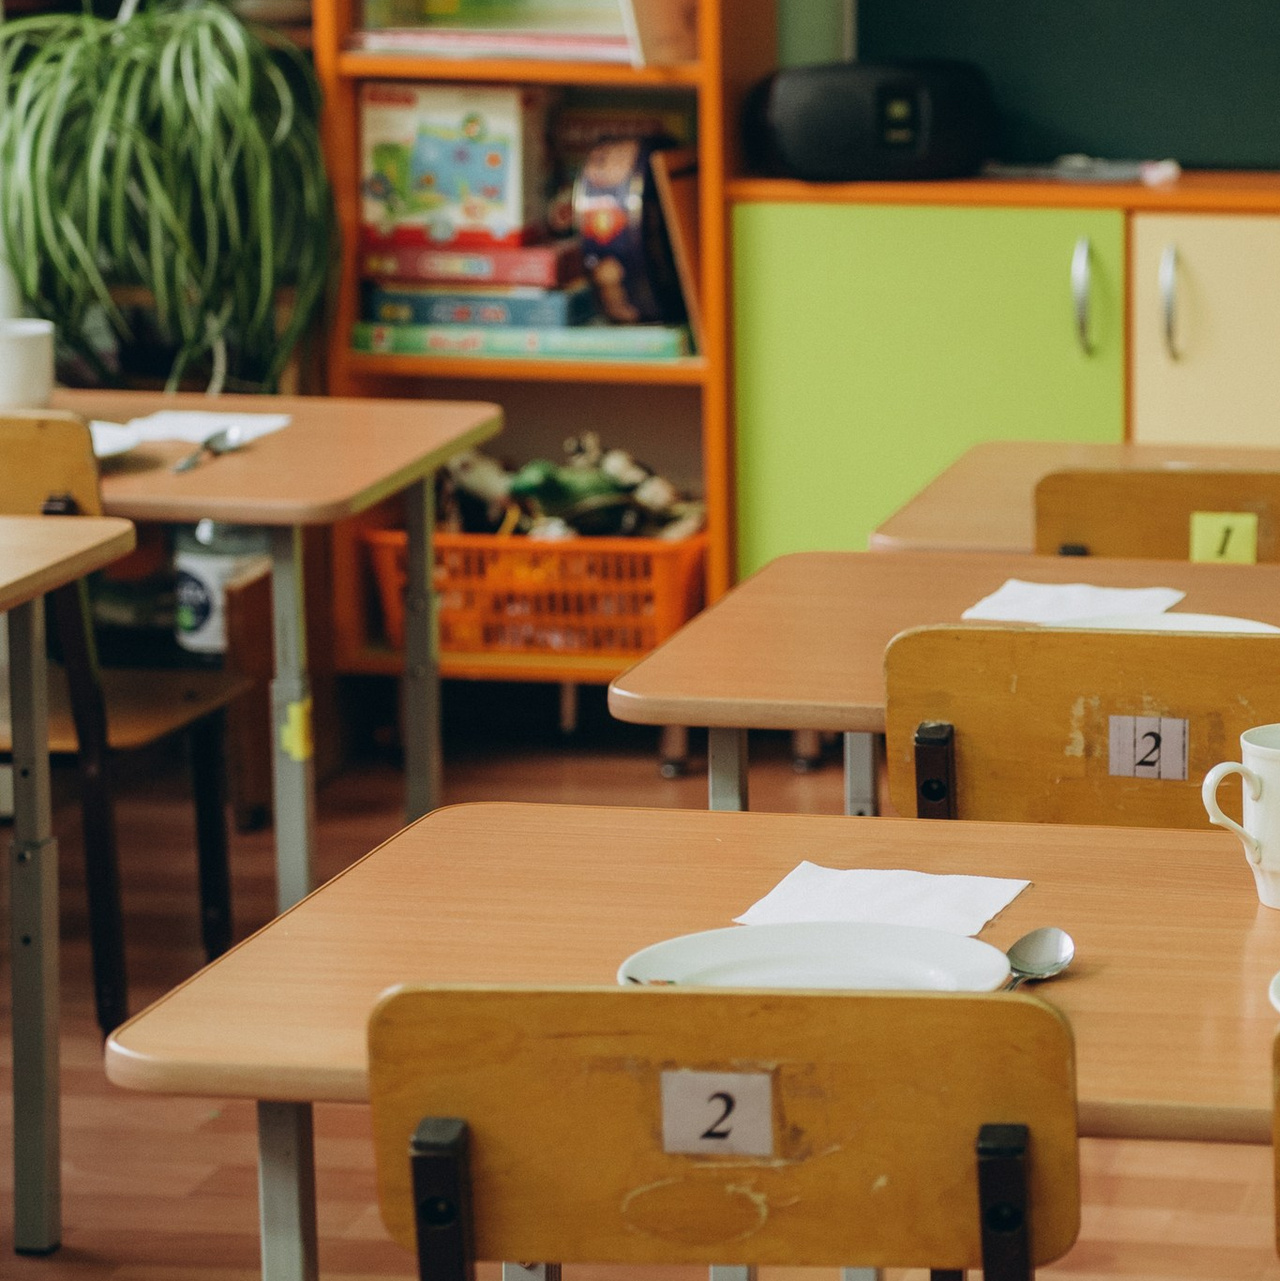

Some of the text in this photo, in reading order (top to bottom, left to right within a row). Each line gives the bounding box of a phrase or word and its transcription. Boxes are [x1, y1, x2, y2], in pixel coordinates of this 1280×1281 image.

[1217, 526, 1233, 557] 1
[1135, 730, 1162, 768] 2
[700, 1091, 736, 1140] 2
